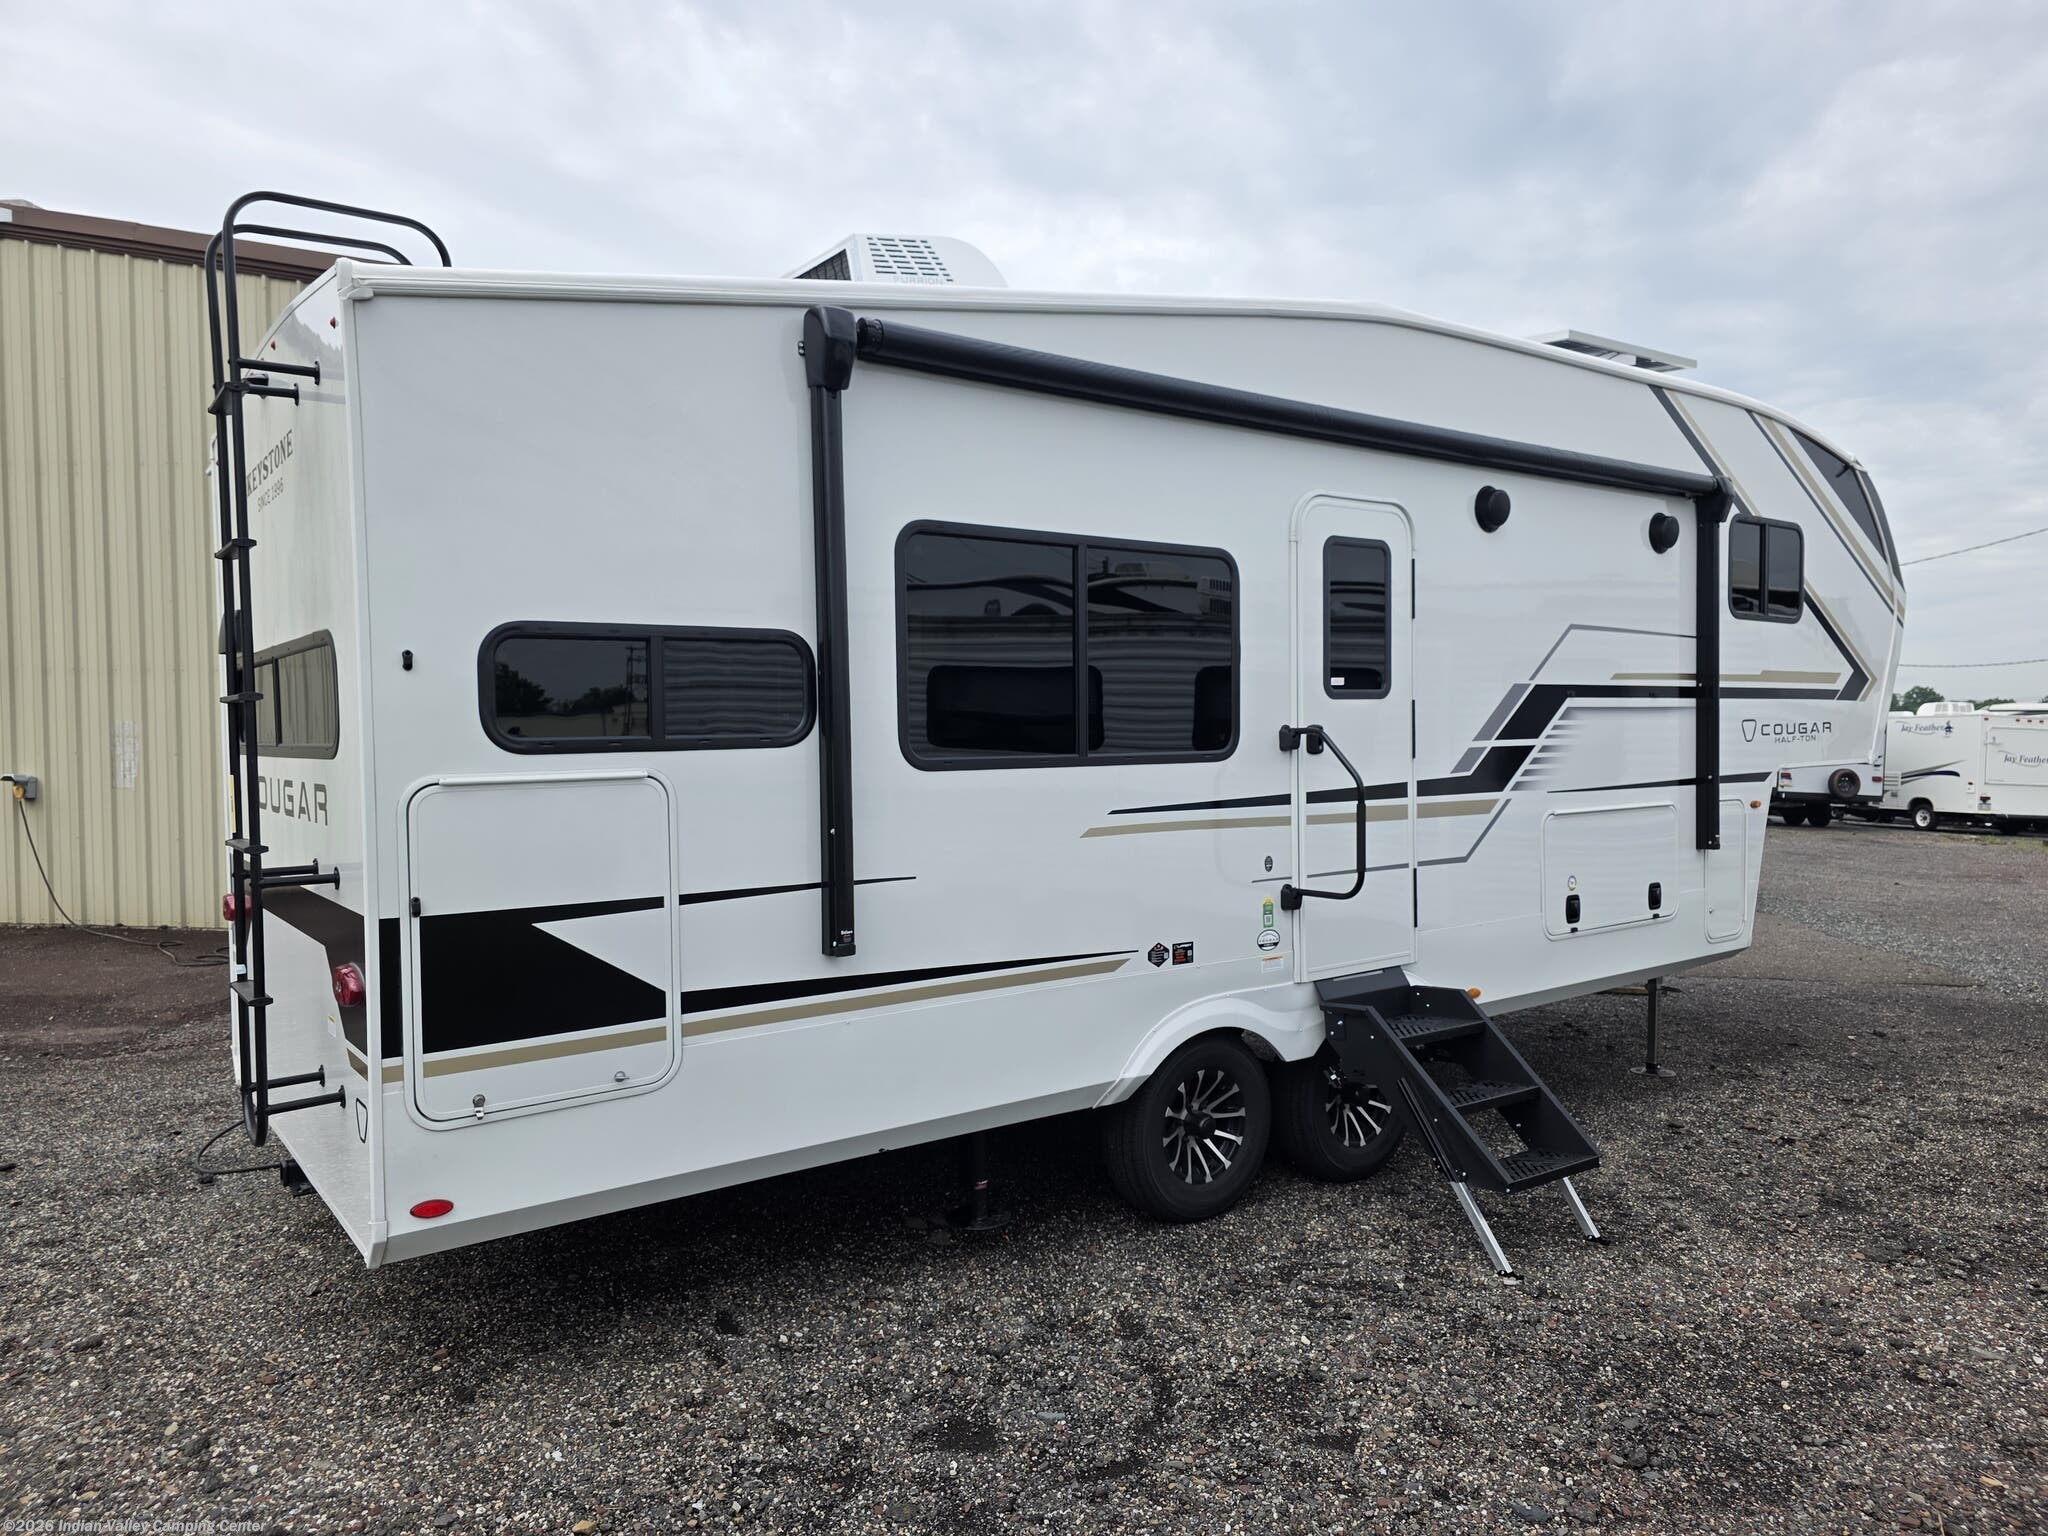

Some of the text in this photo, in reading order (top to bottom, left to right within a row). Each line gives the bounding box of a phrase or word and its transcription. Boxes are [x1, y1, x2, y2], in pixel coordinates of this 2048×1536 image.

[246, 428, 293, 497] KEYSTONE
[1761, 721, 1832, 736] COUGAR
[1774, 735, 1817, 743] HALF-TON
[2004, 754, 2048, 764] Jay Feathe
[258, 775, 328, 826] OUGAR
